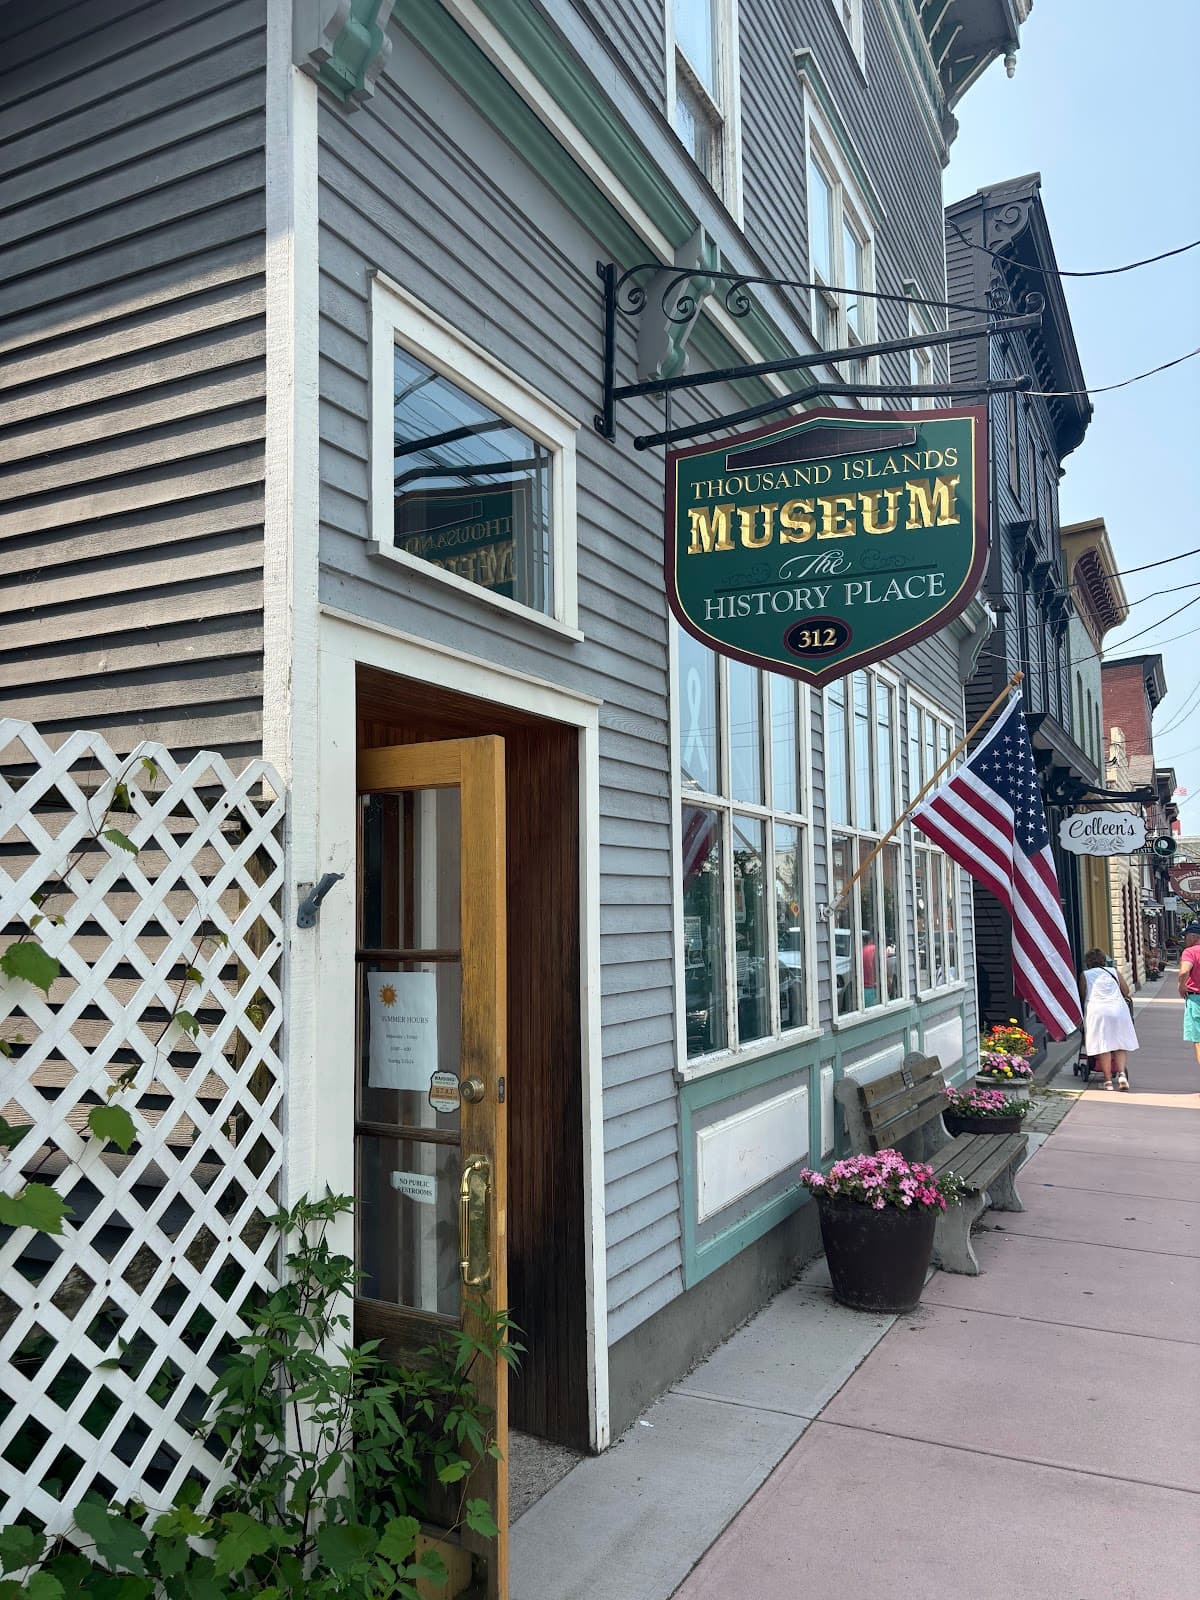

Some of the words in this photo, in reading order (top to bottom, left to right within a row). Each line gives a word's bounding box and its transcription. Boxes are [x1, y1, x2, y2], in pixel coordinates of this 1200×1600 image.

[690, 464, 833, 500] THOUSAND
[842, 447, 959, 481] ISLANDS
[687, 473, 961, 555] MUSEUM
[778, 549, 852, 581] The
[703, 585, 833, 621] HISTORY
[844, 572, 947, 606] PLACE
[797, 627, 838, 649] 312
[1068, 817, 1137, 839] Colleen's
[399, 1177, 408, 1185] NO
[408, 1179, 431, 1188] PUBLIC
